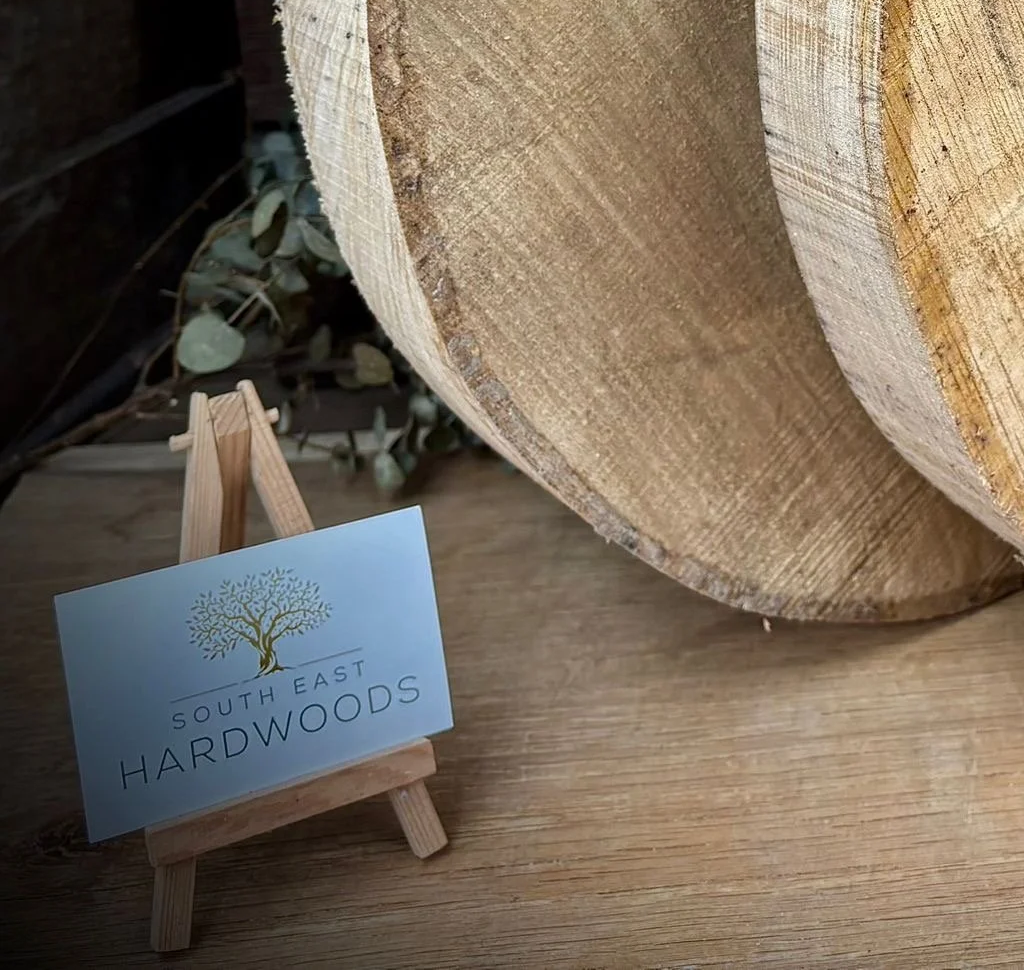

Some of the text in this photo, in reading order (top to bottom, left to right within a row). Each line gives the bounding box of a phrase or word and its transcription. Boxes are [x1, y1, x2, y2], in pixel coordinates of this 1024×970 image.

[120, 675, 421, 790] HARDWOODS
[172, 660, 366, 730] SOUTH EAST
